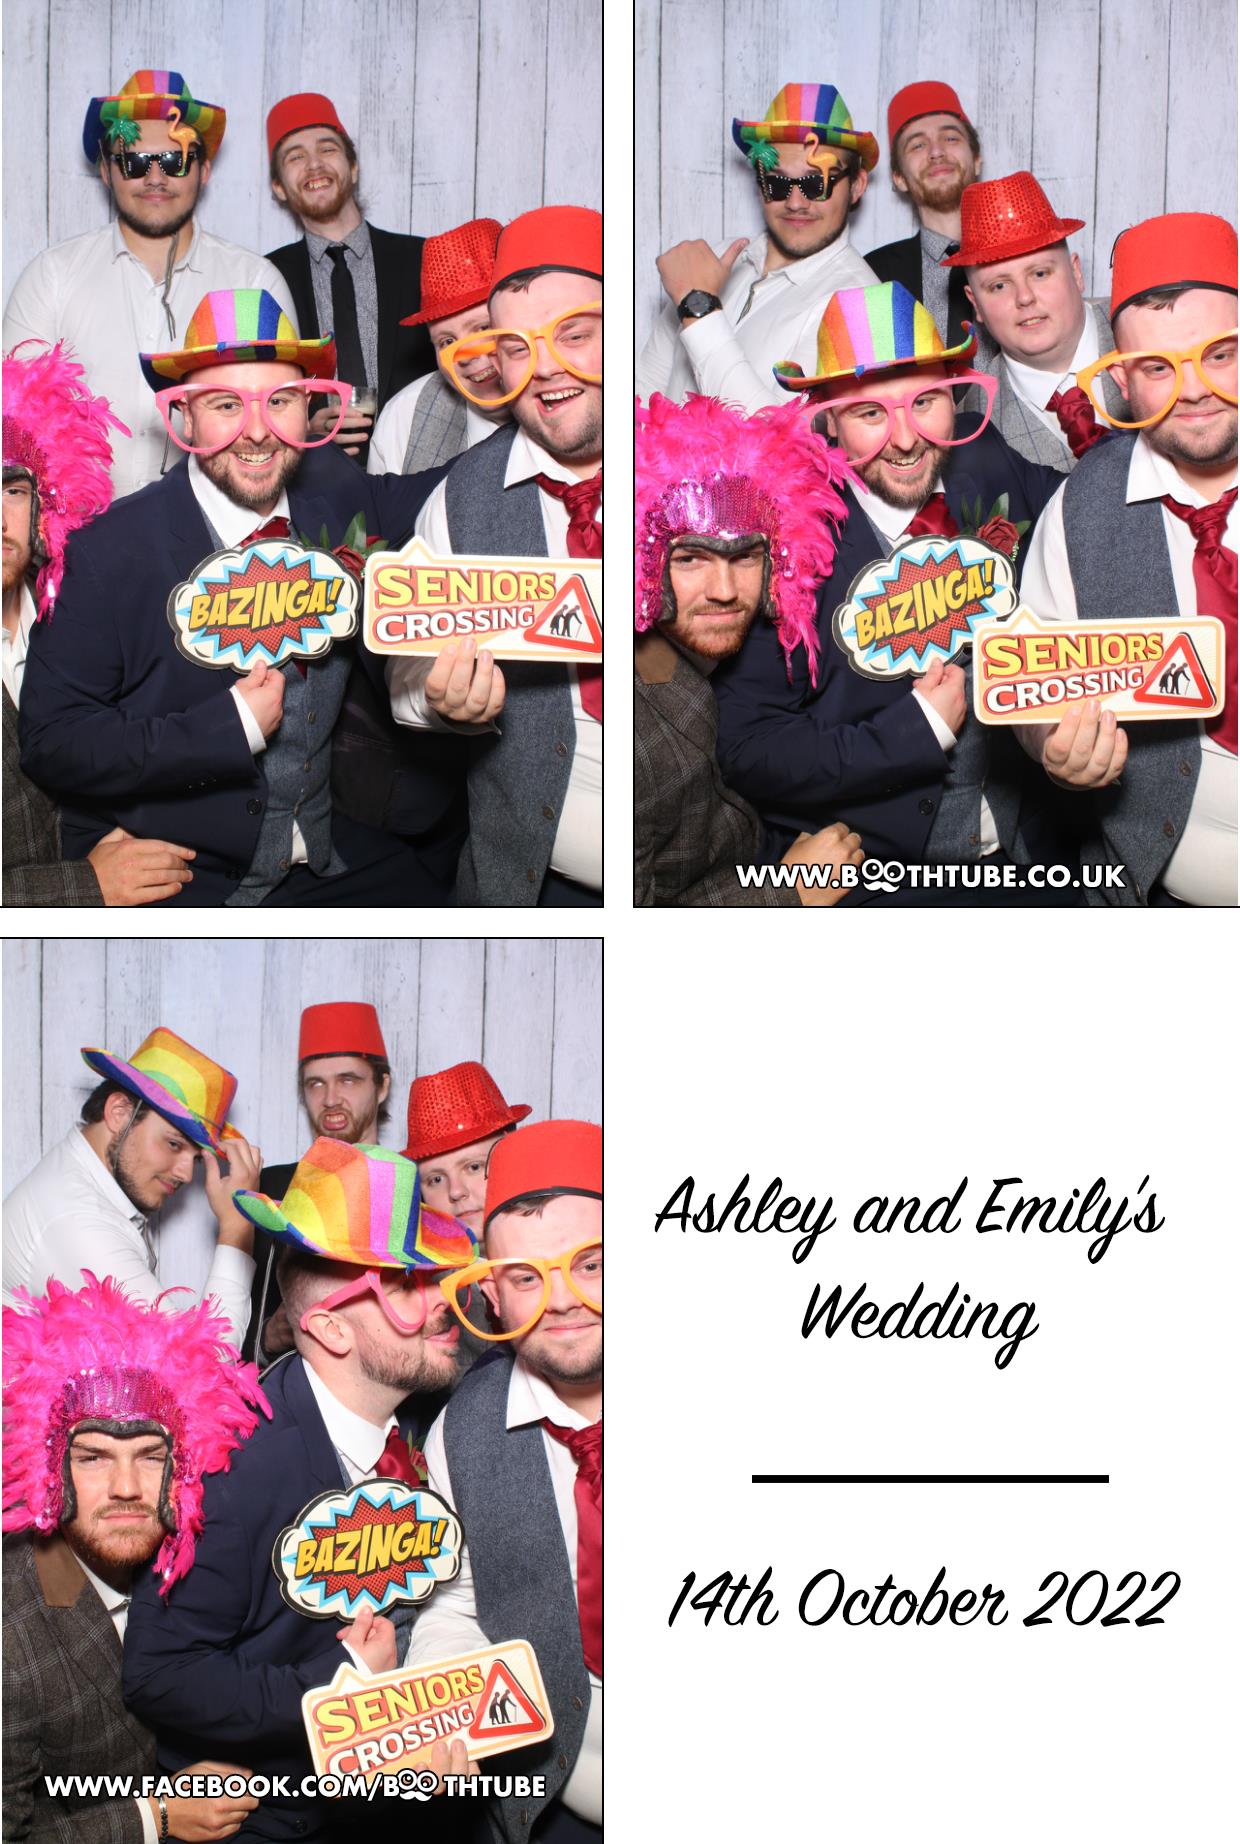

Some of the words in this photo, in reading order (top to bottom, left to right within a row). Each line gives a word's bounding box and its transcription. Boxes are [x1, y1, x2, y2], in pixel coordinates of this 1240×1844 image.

[189, 578, 344, 630] BAZINGA!
[376, 567, 556, 608] SENIORS
[855, 559, 996, 648] BAZINGA!
[376, 605, 535, 643] CROSSING
[985, 633, 1164, 678] SENIORS
[987, 667, 1145, 714] CROSSING
[295, 1519, 448, 1578] BAZINGA!
[316, 1664, 486, 1745] SENIORS
[328, 1702, 476, 1779] CROSSING
